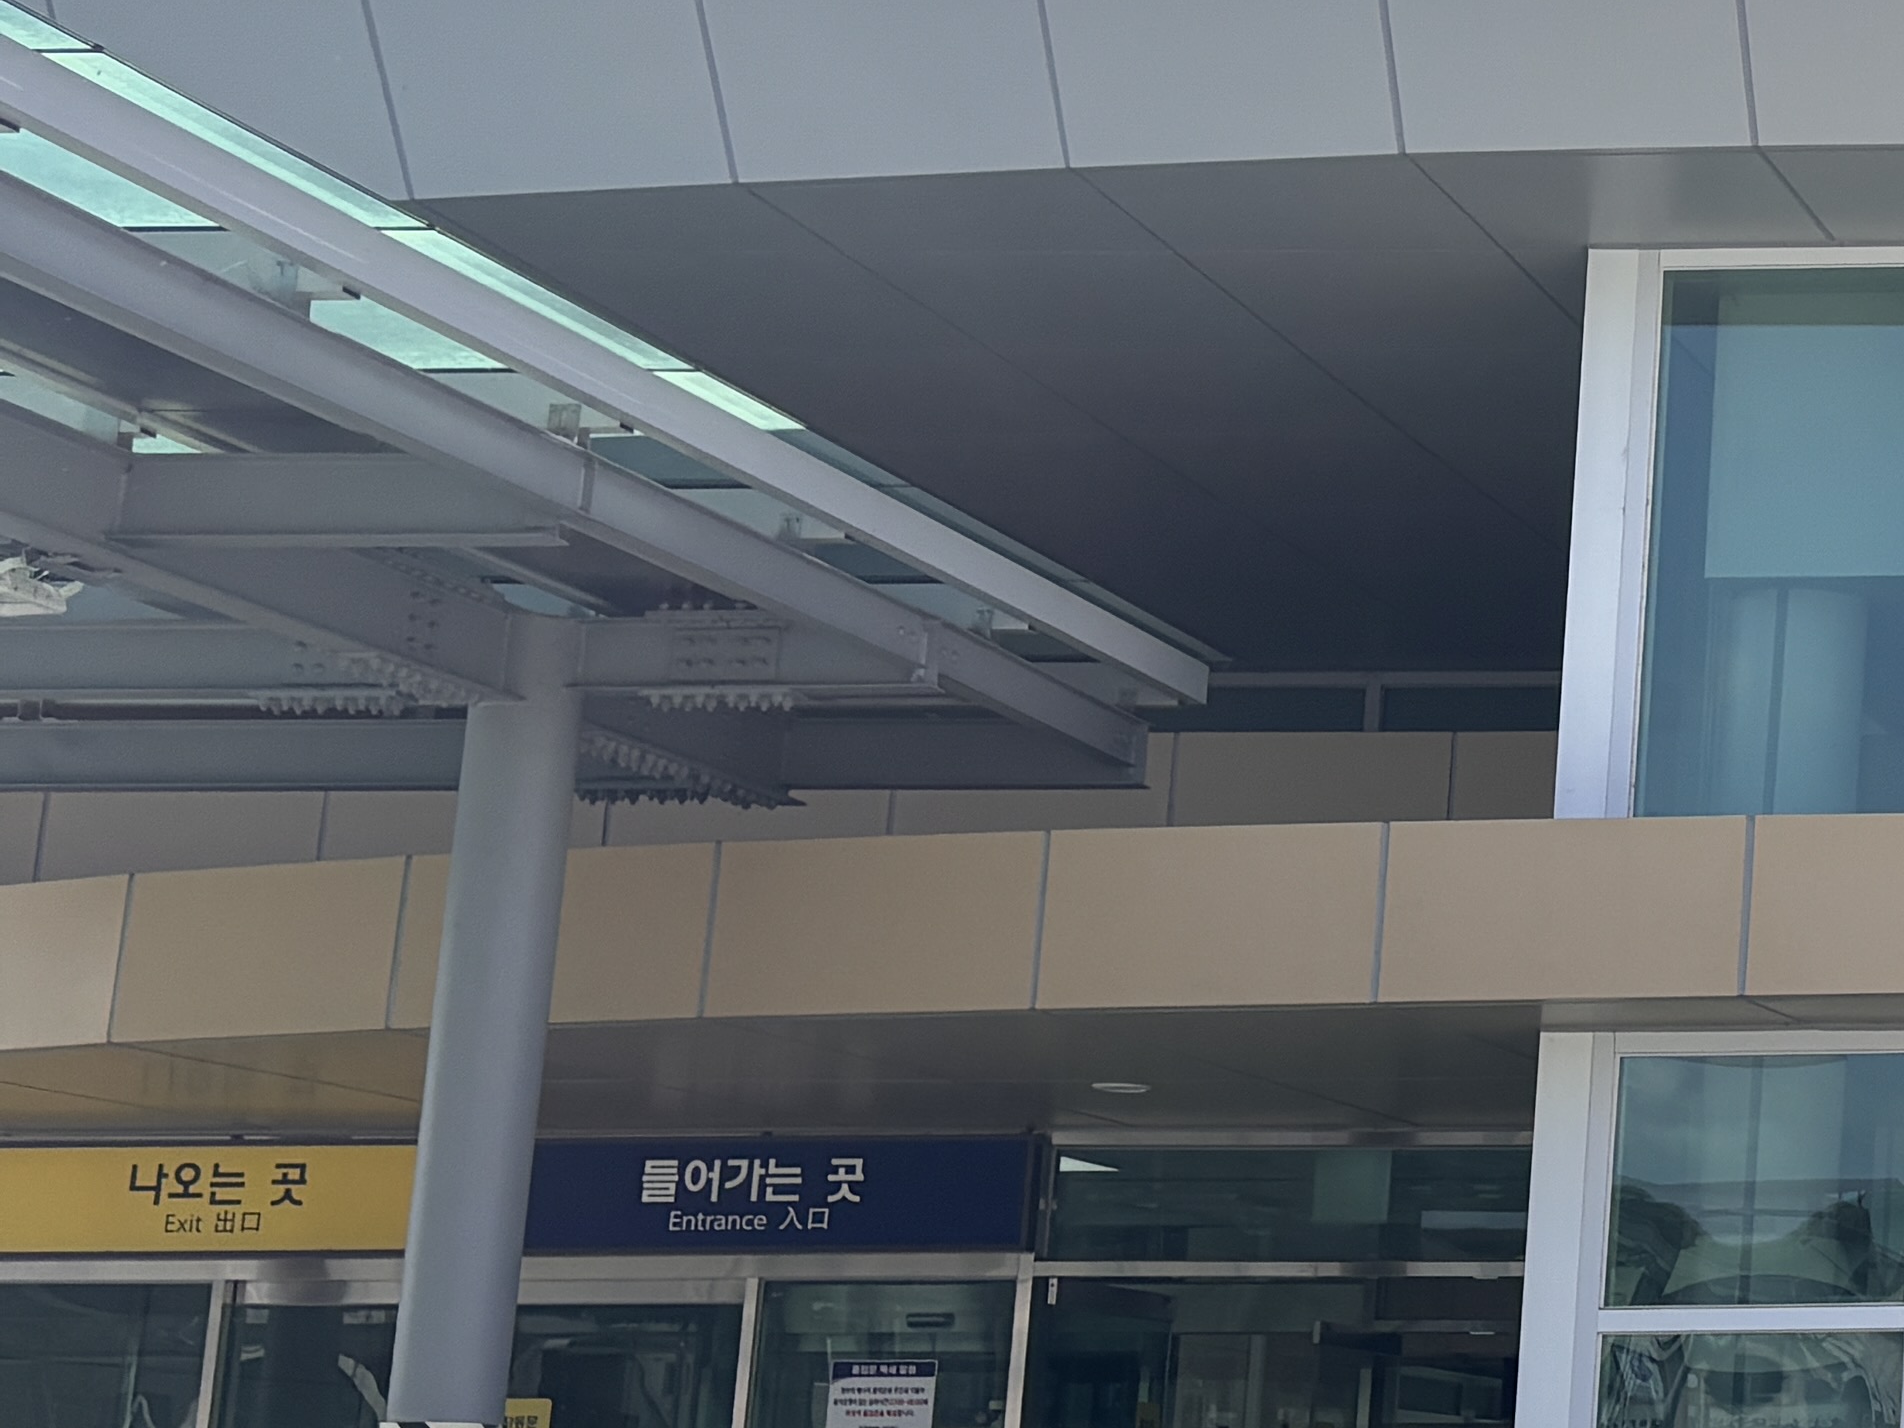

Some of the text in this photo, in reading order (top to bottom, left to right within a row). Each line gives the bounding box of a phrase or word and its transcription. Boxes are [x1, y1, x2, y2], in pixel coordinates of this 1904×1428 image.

[129, 1162, 307, 1206] 나오는 곳
[641, 1158, 865, 1203] 들어가는 곳
[164, 1209, 261, 1234] Exit 出口
[668, 1206, 830, 1231] Entrance 入口
